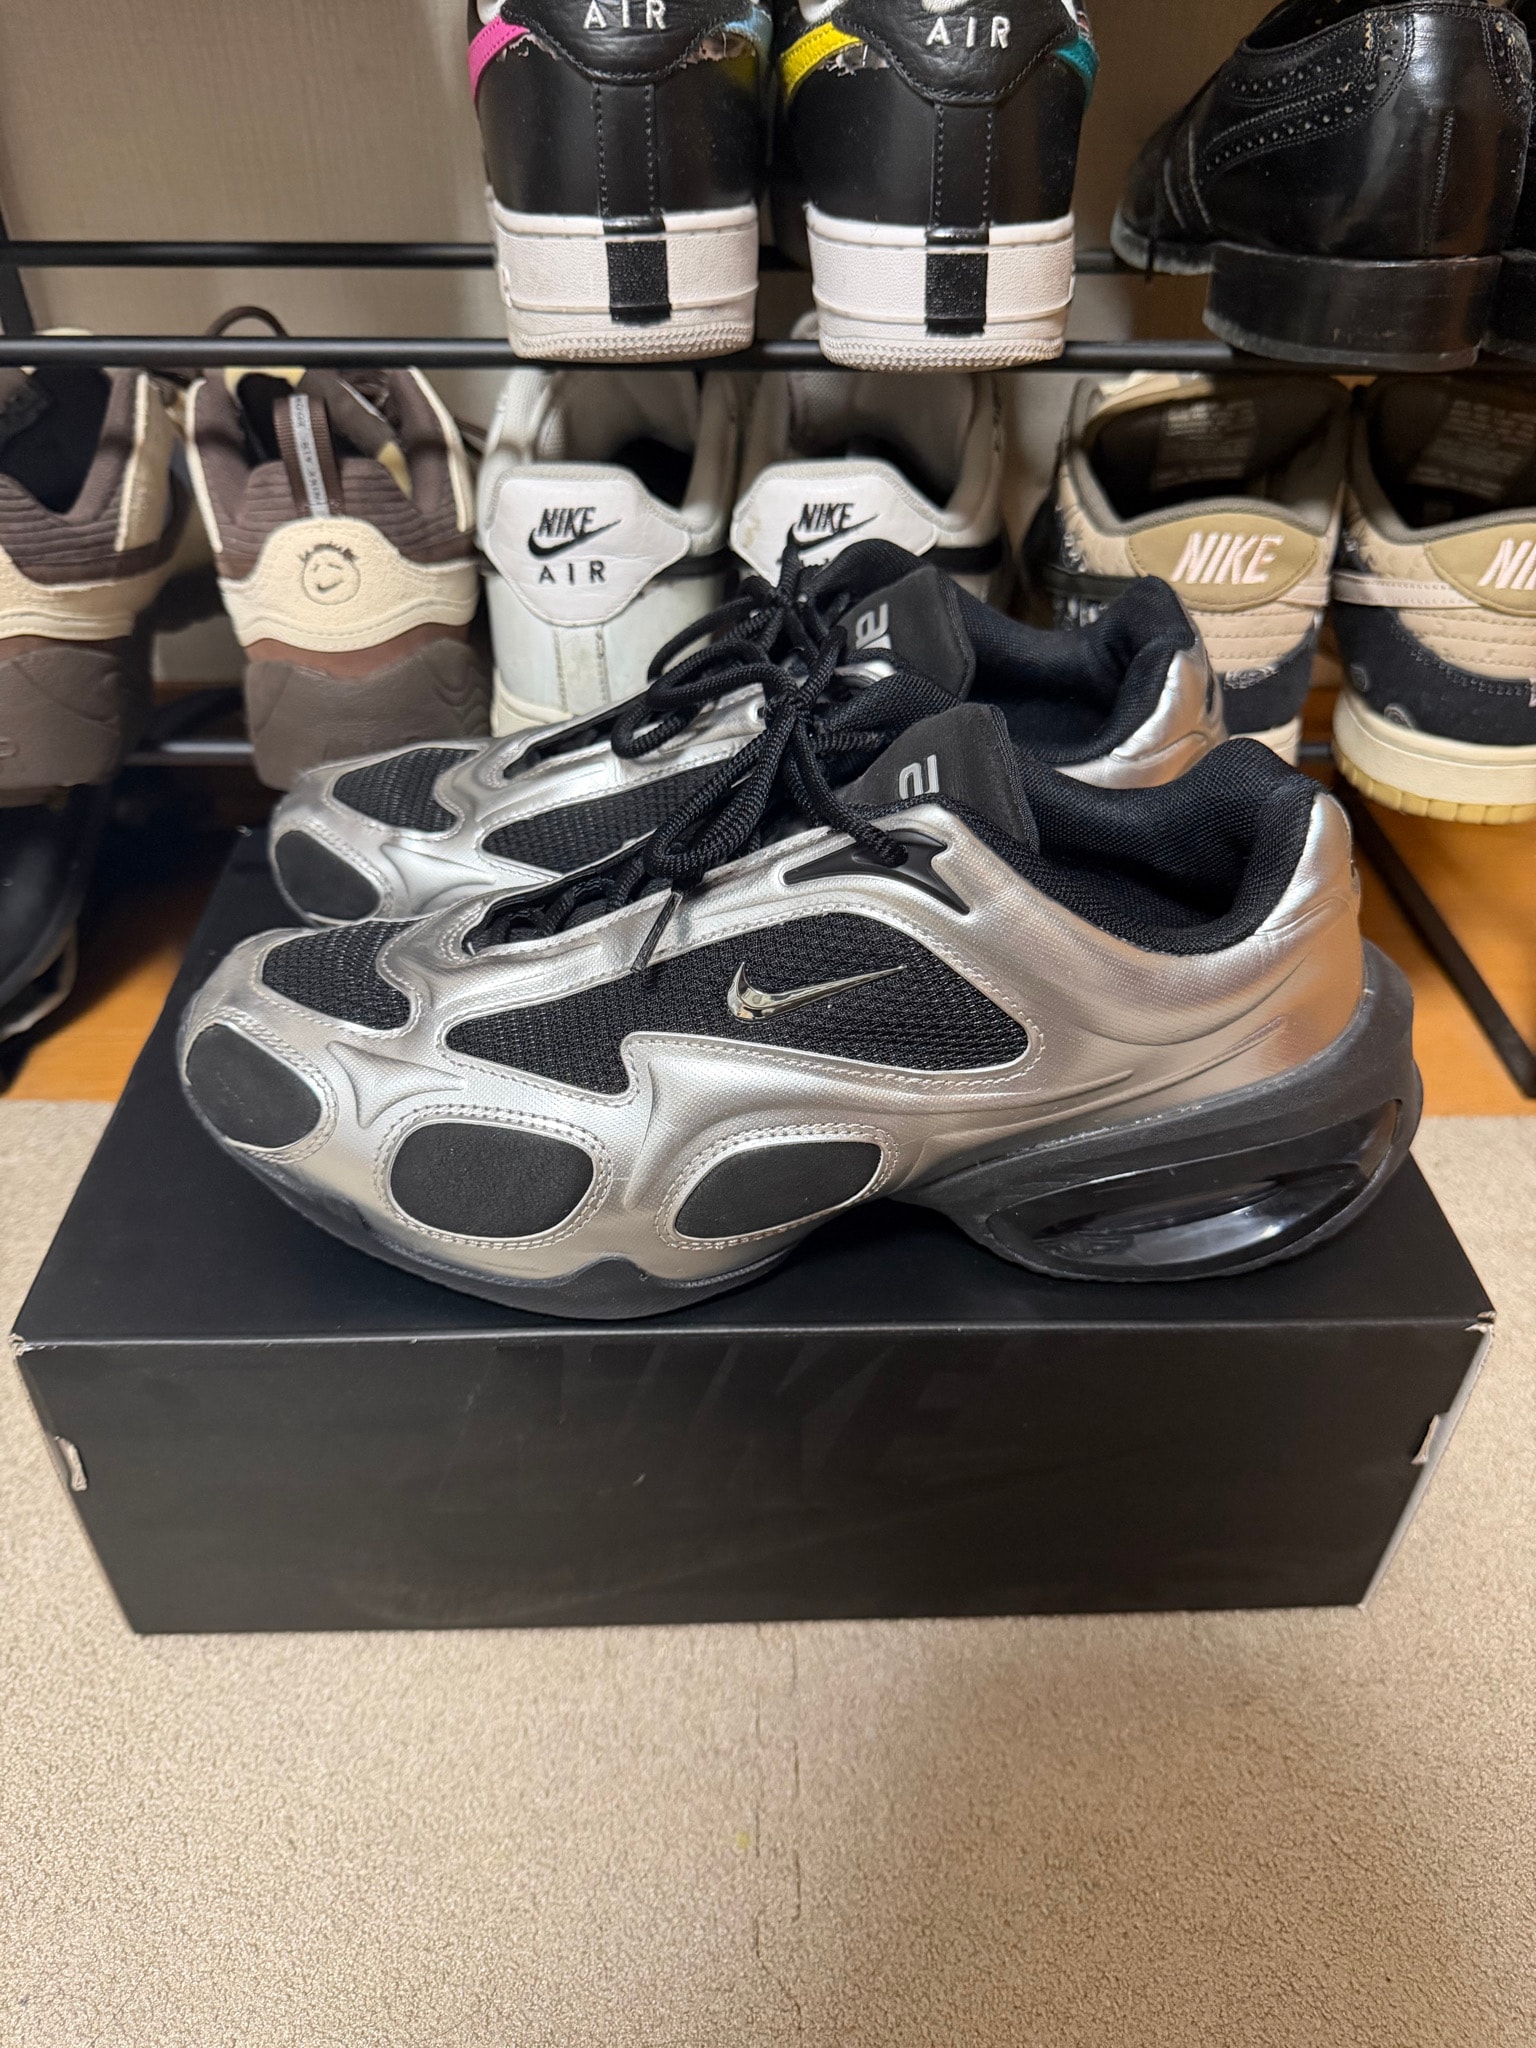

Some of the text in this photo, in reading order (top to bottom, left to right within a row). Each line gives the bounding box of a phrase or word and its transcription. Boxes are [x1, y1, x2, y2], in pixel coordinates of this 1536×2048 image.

[582, 0, 667, 30] AIR
[925, 15, 1012, 50] AIR
[538, 507, 597, 540] NIKE
[797, 502, 855, 534] NIKE
[539, 560, 607, 586] AIR
[1170, 530, 1285, 585] NIKE
